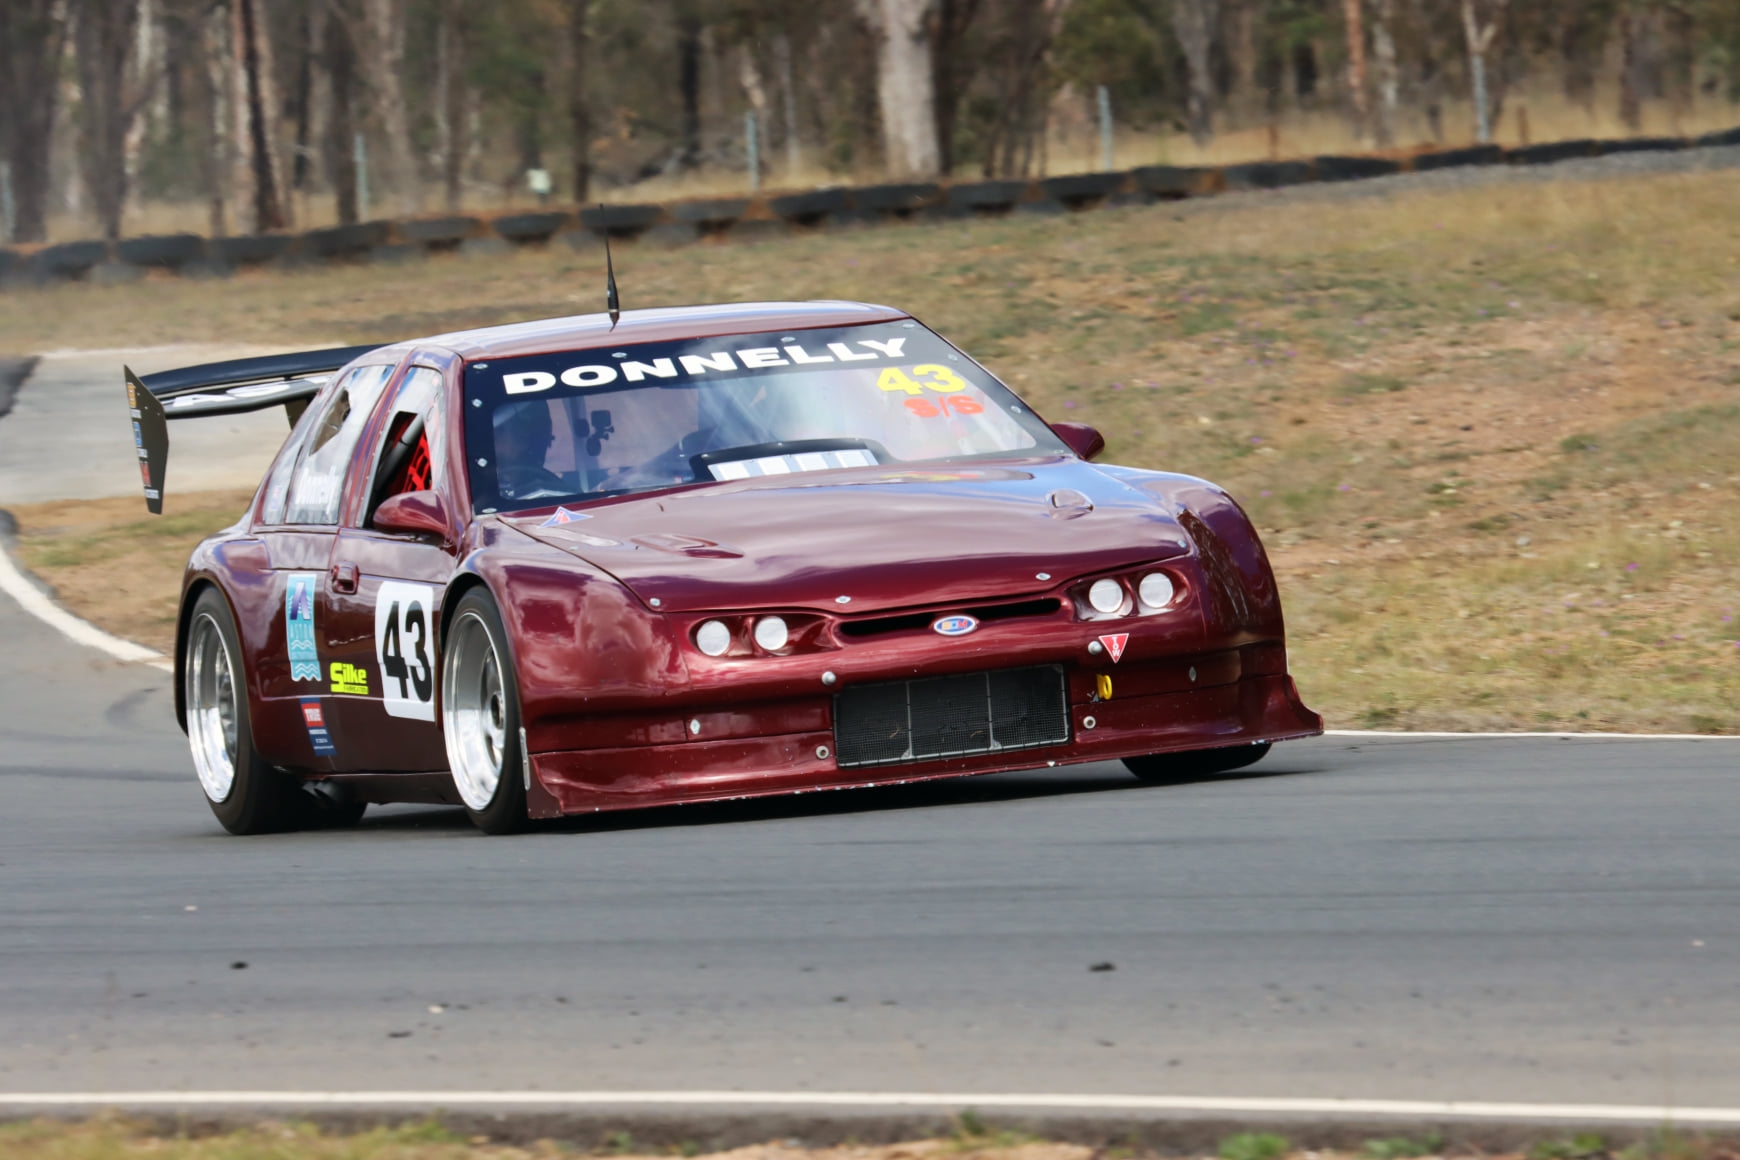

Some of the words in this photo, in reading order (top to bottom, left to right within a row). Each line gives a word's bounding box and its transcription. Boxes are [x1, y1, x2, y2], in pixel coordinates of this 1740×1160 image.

[503, 338, 906, 395] DONNELLY
[877, 364, 966, 395] 43
[383, 600, 432, 702] 43
[1111, 636, 1121, 657] TOW
[330, 662, 367, 692] Silke
